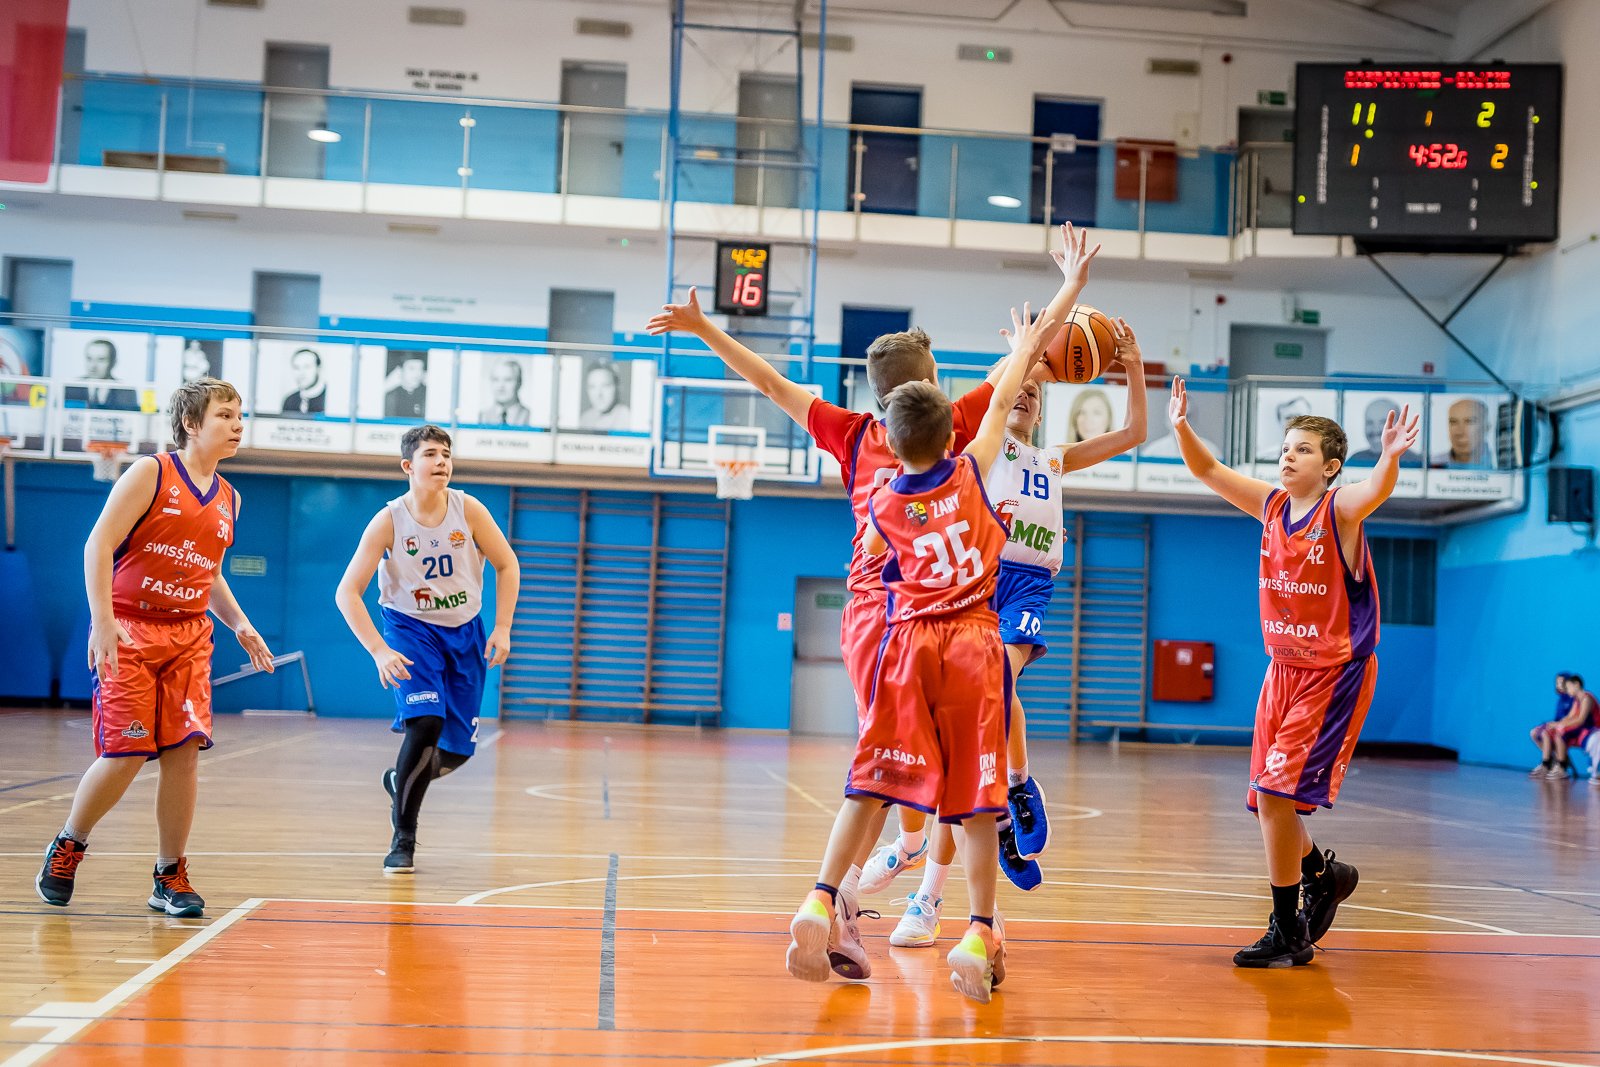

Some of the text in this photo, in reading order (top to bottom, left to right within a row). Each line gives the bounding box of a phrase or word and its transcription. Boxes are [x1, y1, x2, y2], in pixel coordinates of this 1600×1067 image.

[1352, 102, 1377, 126] 11
[1476, 101, 1495, 128] 2
[1350, 144, 1361, 167] 1
[1490, 143, 1509, 169] 2
[732, 273, 763, 306] 16
[1020, 468, 1050, 500] 19
[930, 494, 961, 519] ŻARY
[182, 540, 196, 551] BC
[1015, 519, 1056, 553] MOS
[143, 542, 185, 560] SWISS
[912, 520, 984, 589] 35
[1306, 544, 1325, 565] 42
[422, 554, 454, 580] 20
[1278, 569, 1289, 580] BC
[433, 590, 468, 610] MOS
[1284, 581, 1328, 596] KRONO
[1263, 619, 1319, 638] FASADA
[873, 747, 927, 767] FASADA
